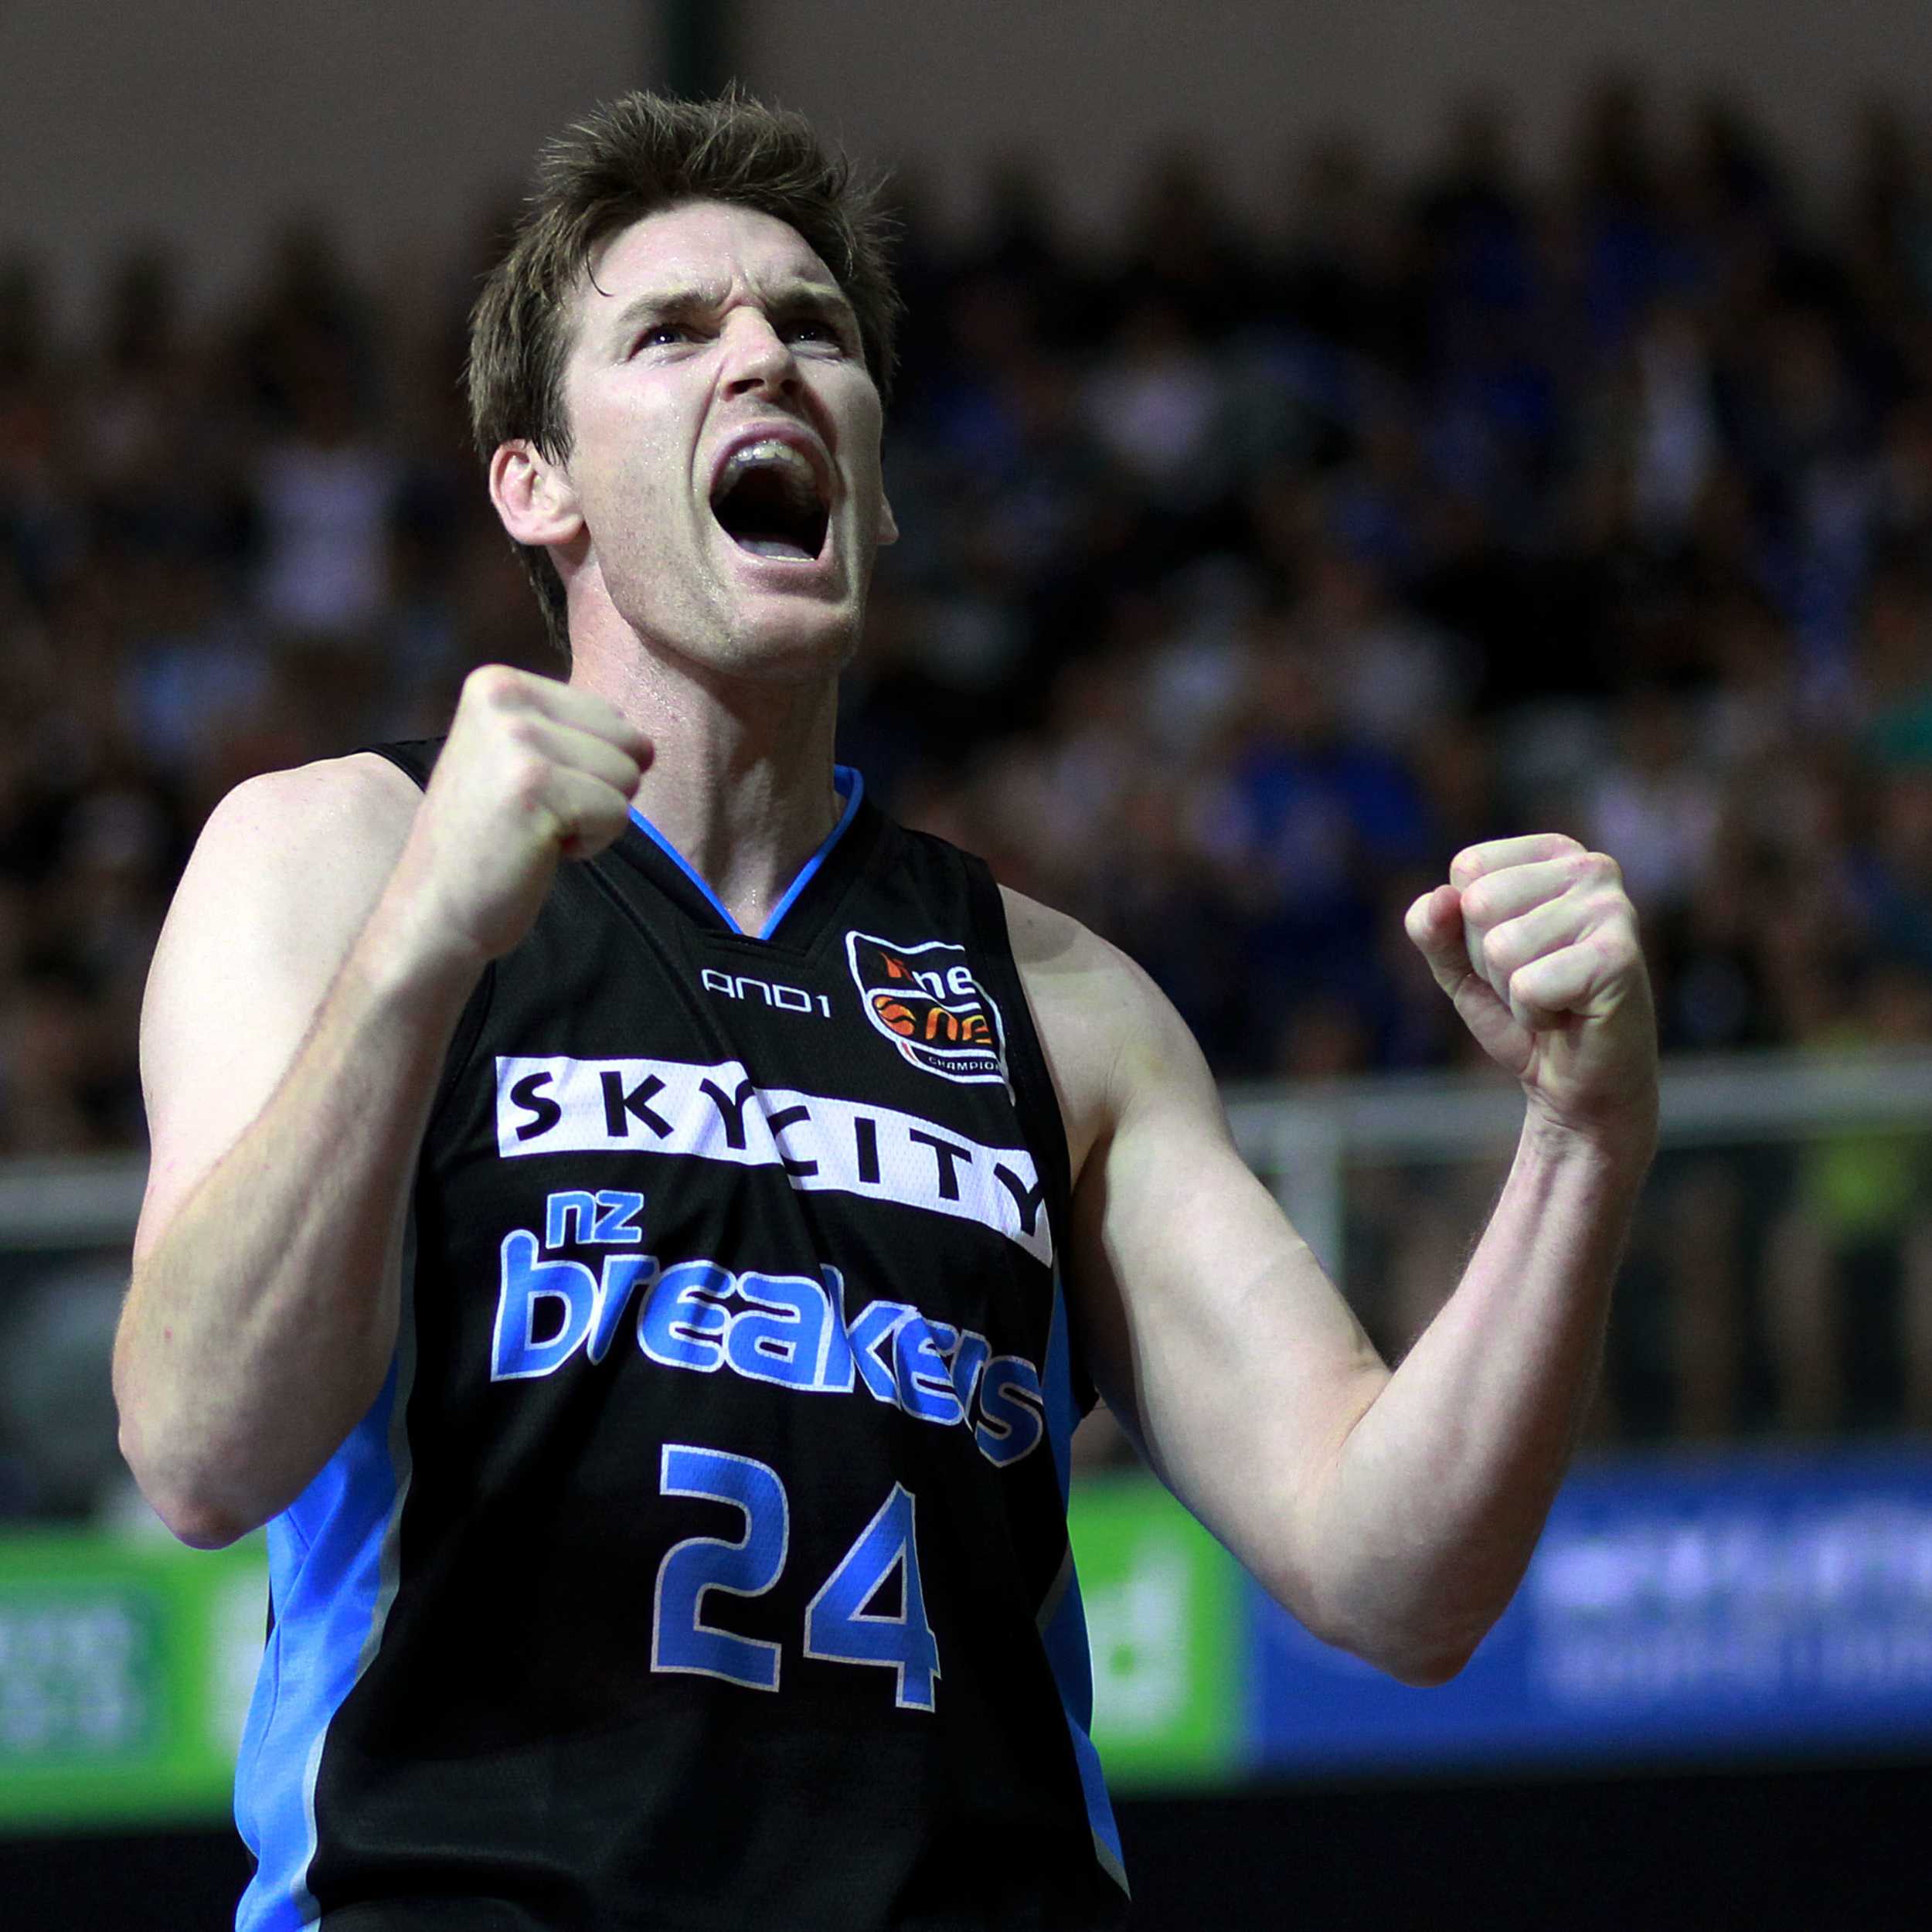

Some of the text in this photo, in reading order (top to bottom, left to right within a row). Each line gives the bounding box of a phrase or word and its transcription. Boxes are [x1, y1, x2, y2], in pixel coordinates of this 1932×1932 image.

[701, 968, 831, 1019] AND1
[511, 1071, 1043, 1236] SKYCITY
[491, 1229, 1044, 1468] breakers
[650, 1443, 942, 1713] 24
